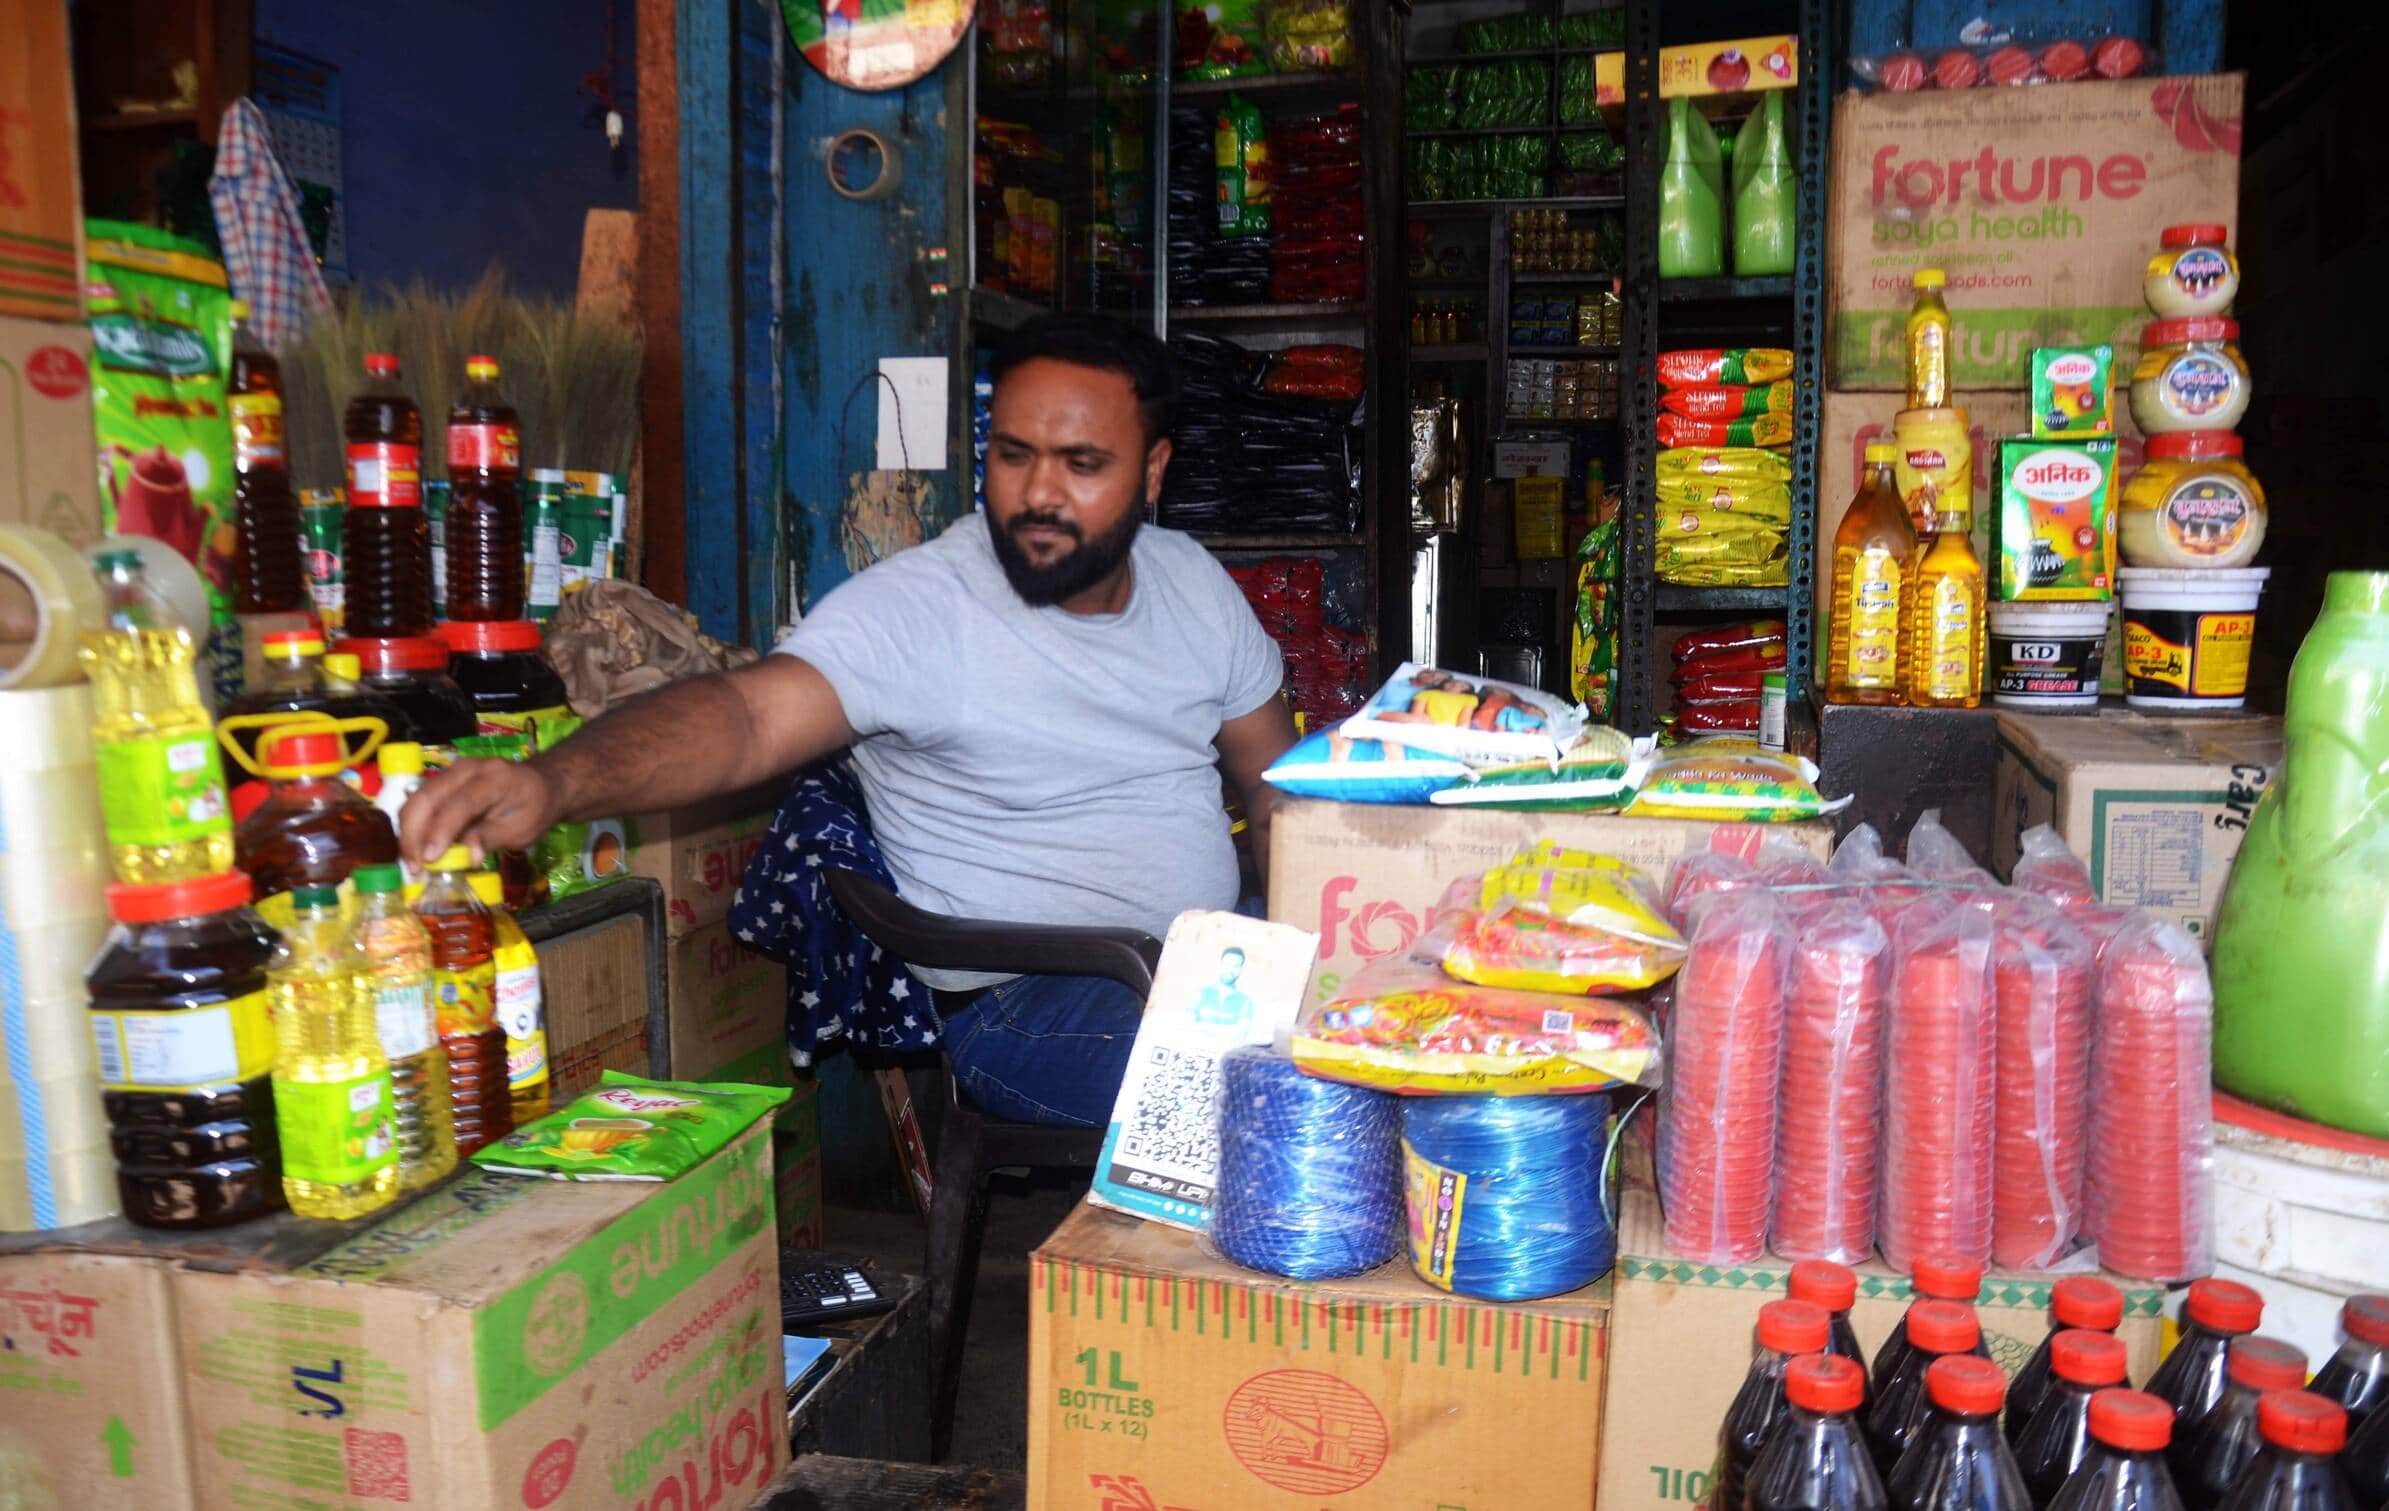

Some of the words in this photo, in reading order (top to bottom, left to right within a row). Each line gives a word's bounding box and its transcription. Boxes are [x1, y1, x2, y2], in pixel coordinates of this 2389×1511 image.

[1872, 144, 2147, 208] fortune
[1872, 214, 1960, 250] soya
[1969, 206, 2085, 242] health
[2024, 463, 2091, 484] अनिक
[2019, 645, 2055, 660] KD
[2001, 679, 2025, 690] AP-3
[1075, 1346, 1140, 1392] 1L
[1058, 1387, 1155, 1419] BOTTLES
[1063, 1412, 1095, 1431] (1L
[1100, 1420, 1113, 1433] x
[1119, 1419, 1149, 1442] 12)
[1649, 1465, 1709, 1503] OIL
